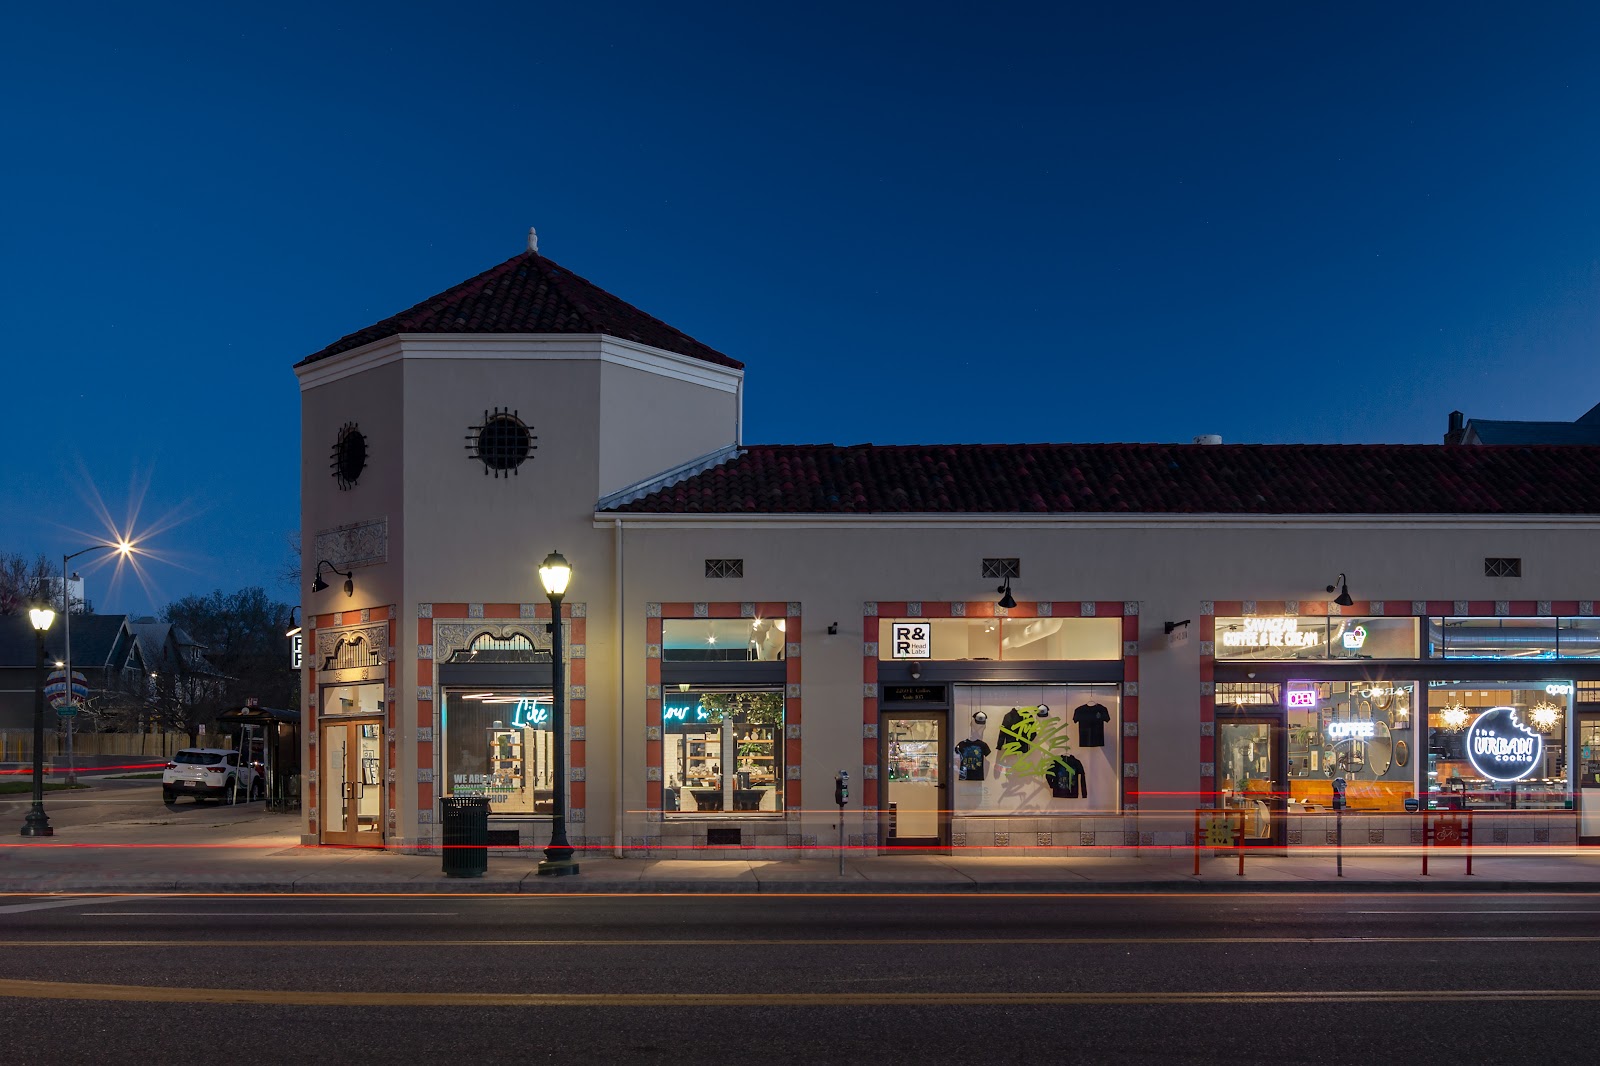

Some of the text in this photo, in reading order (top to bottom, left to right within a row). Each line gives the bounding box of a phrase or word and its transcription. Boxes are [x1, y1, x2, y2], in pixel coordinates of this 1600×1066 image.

[897, 628, 925, 640] R&
[1223, 632, 1258, 646] COFFEE
[1259, 632, 1268, 646] &
[1284, 632, 1318, 646] CREAM
[897, 642, 910, 654] R
[1546, 685, 1573, 695] open
[1290, 692, 1314, 706] OPEN
[511, 697, 548, 728] Like
[1329, 722, 1374, 736] COFFEE
[1475, 737, 1533, 755] URBAN
[454, 774, 466, 783] WE
[468, 774, 483, 783] ARE
[486, 774, 502, 783] NOT
